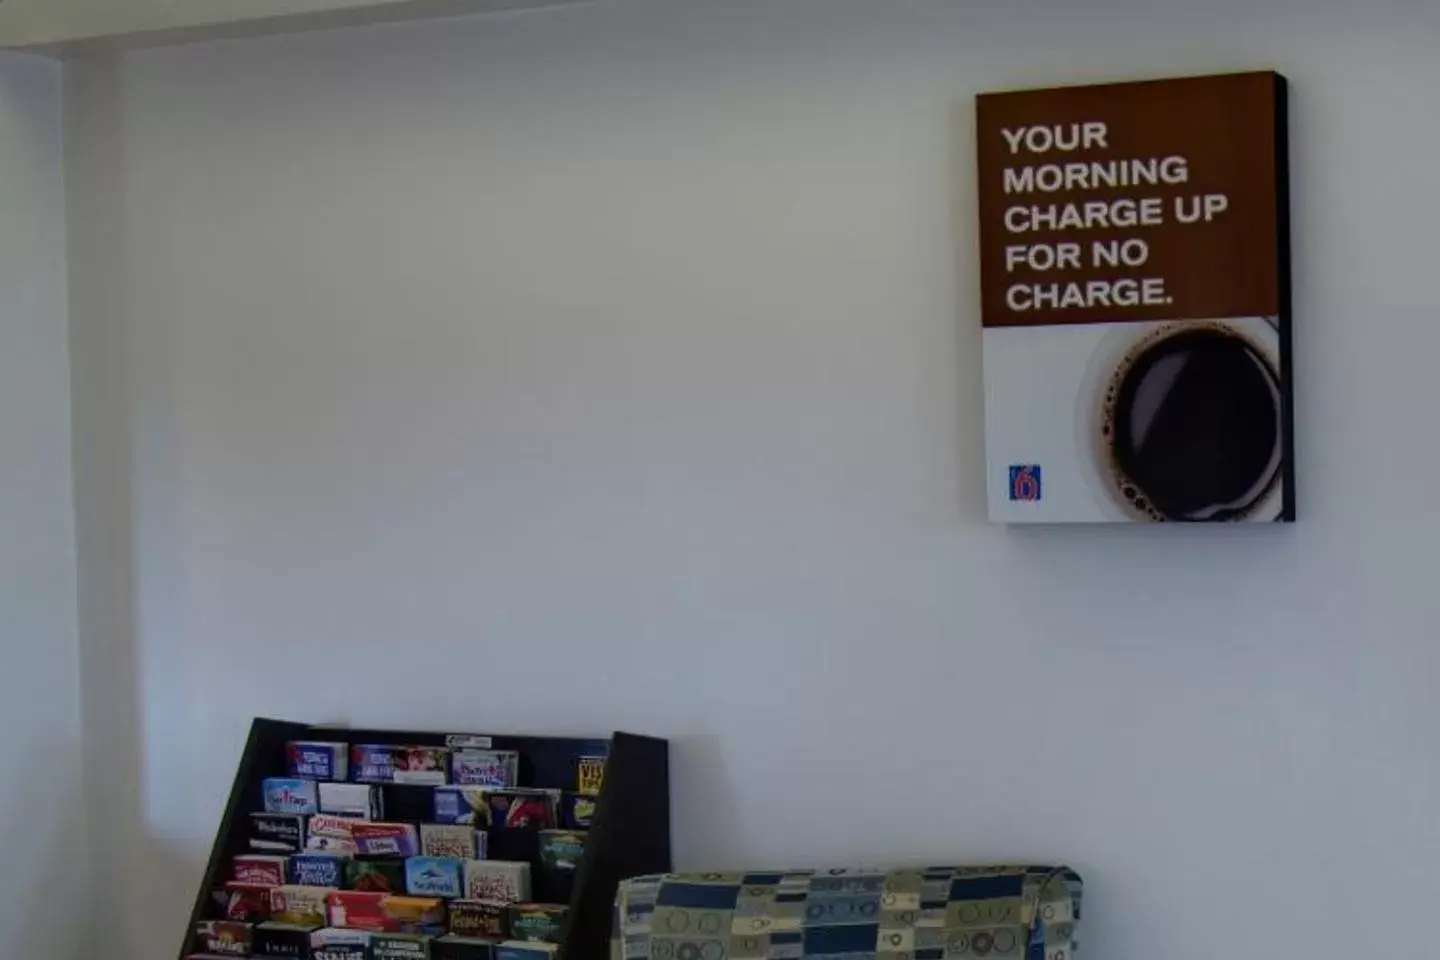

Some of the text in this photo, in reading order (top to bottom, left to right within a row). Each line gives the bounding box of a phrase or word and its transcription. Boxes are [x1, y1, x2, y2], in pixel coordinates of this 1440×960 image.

[1001, 122, 1108, 154] YOUR
[1003, 155, 1189, 194] MORNING
[1004, 193, 1229, 233] CHARGE UP
[1005, 238, 1149, 273] FOR NO
[1006, 277, 1174, 312] CHARGE.
[1014, 464, 1039, 501] 6
